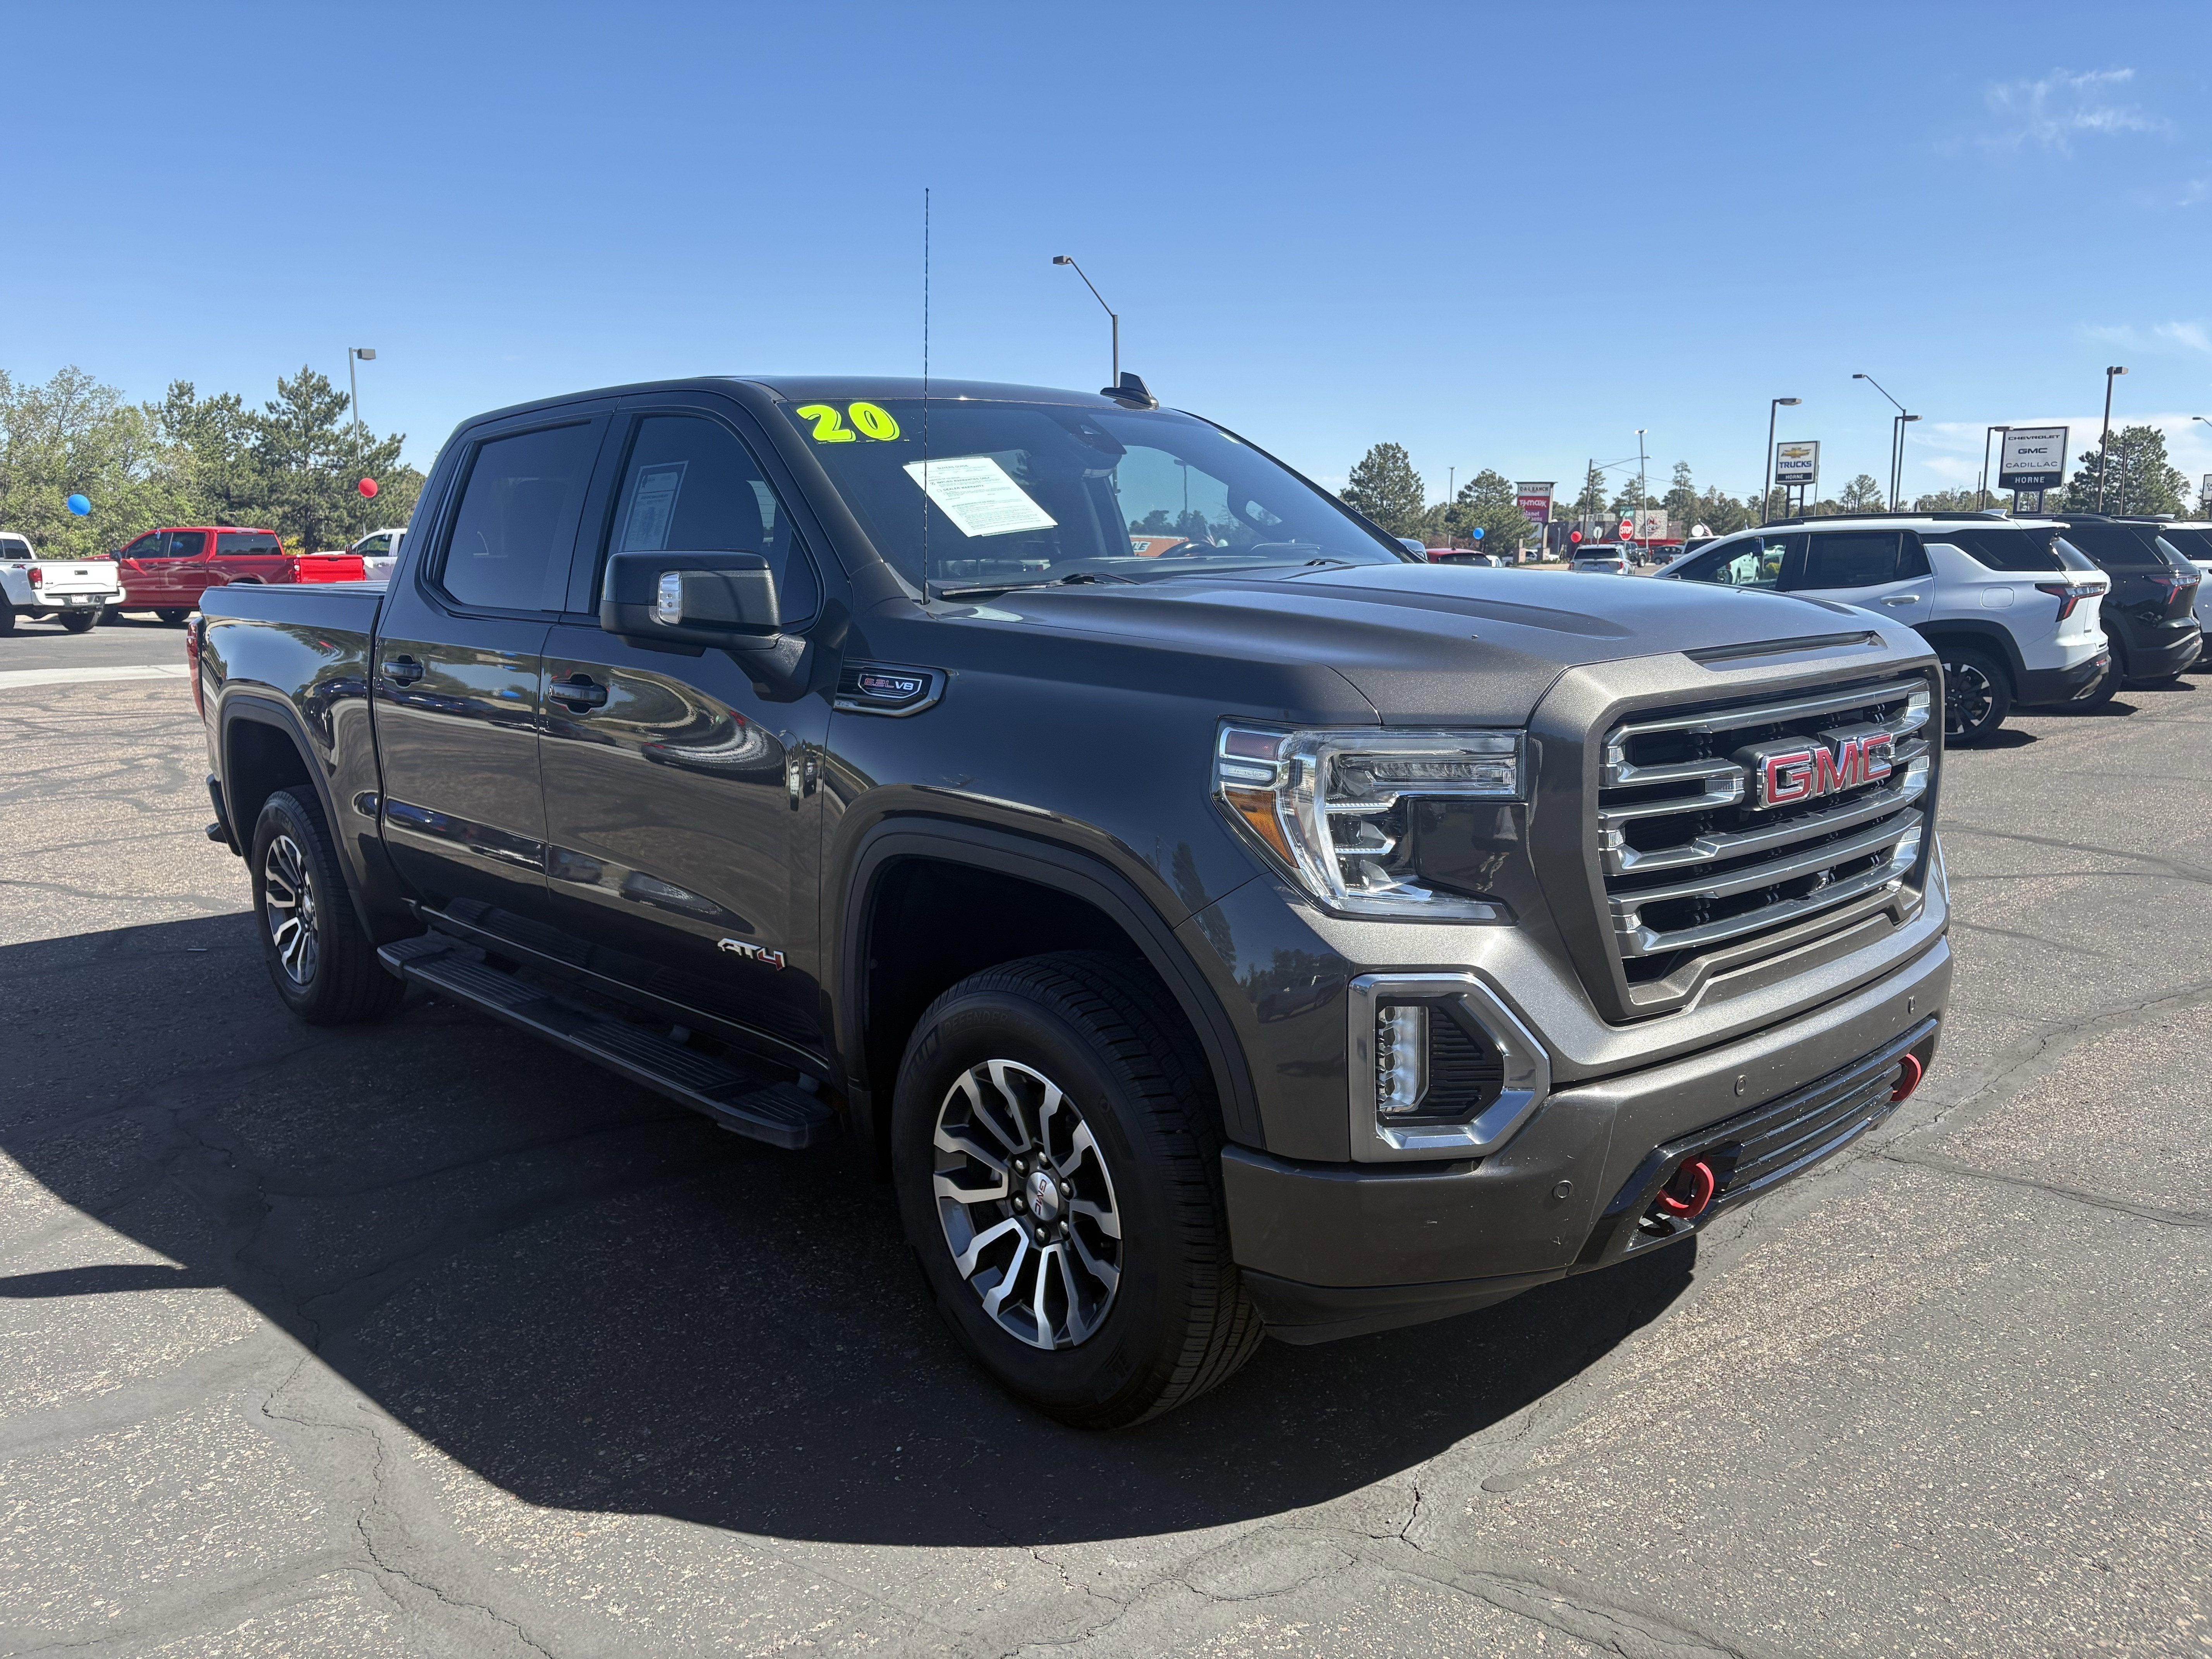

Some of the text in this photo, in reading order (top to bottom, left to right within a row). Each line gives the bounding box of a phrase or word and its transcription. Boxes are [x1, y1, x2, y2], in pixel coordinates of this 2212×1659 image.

[796, 402, 900, 443] 20
[1620, 526, 1632, 534] STOP
[895, 681, 914, 690] V8
[1762, 733, 1894, 808] GMC
[717, 938, 786, 971] AT4
[1034, 1178, 1047, 1216] GMC
